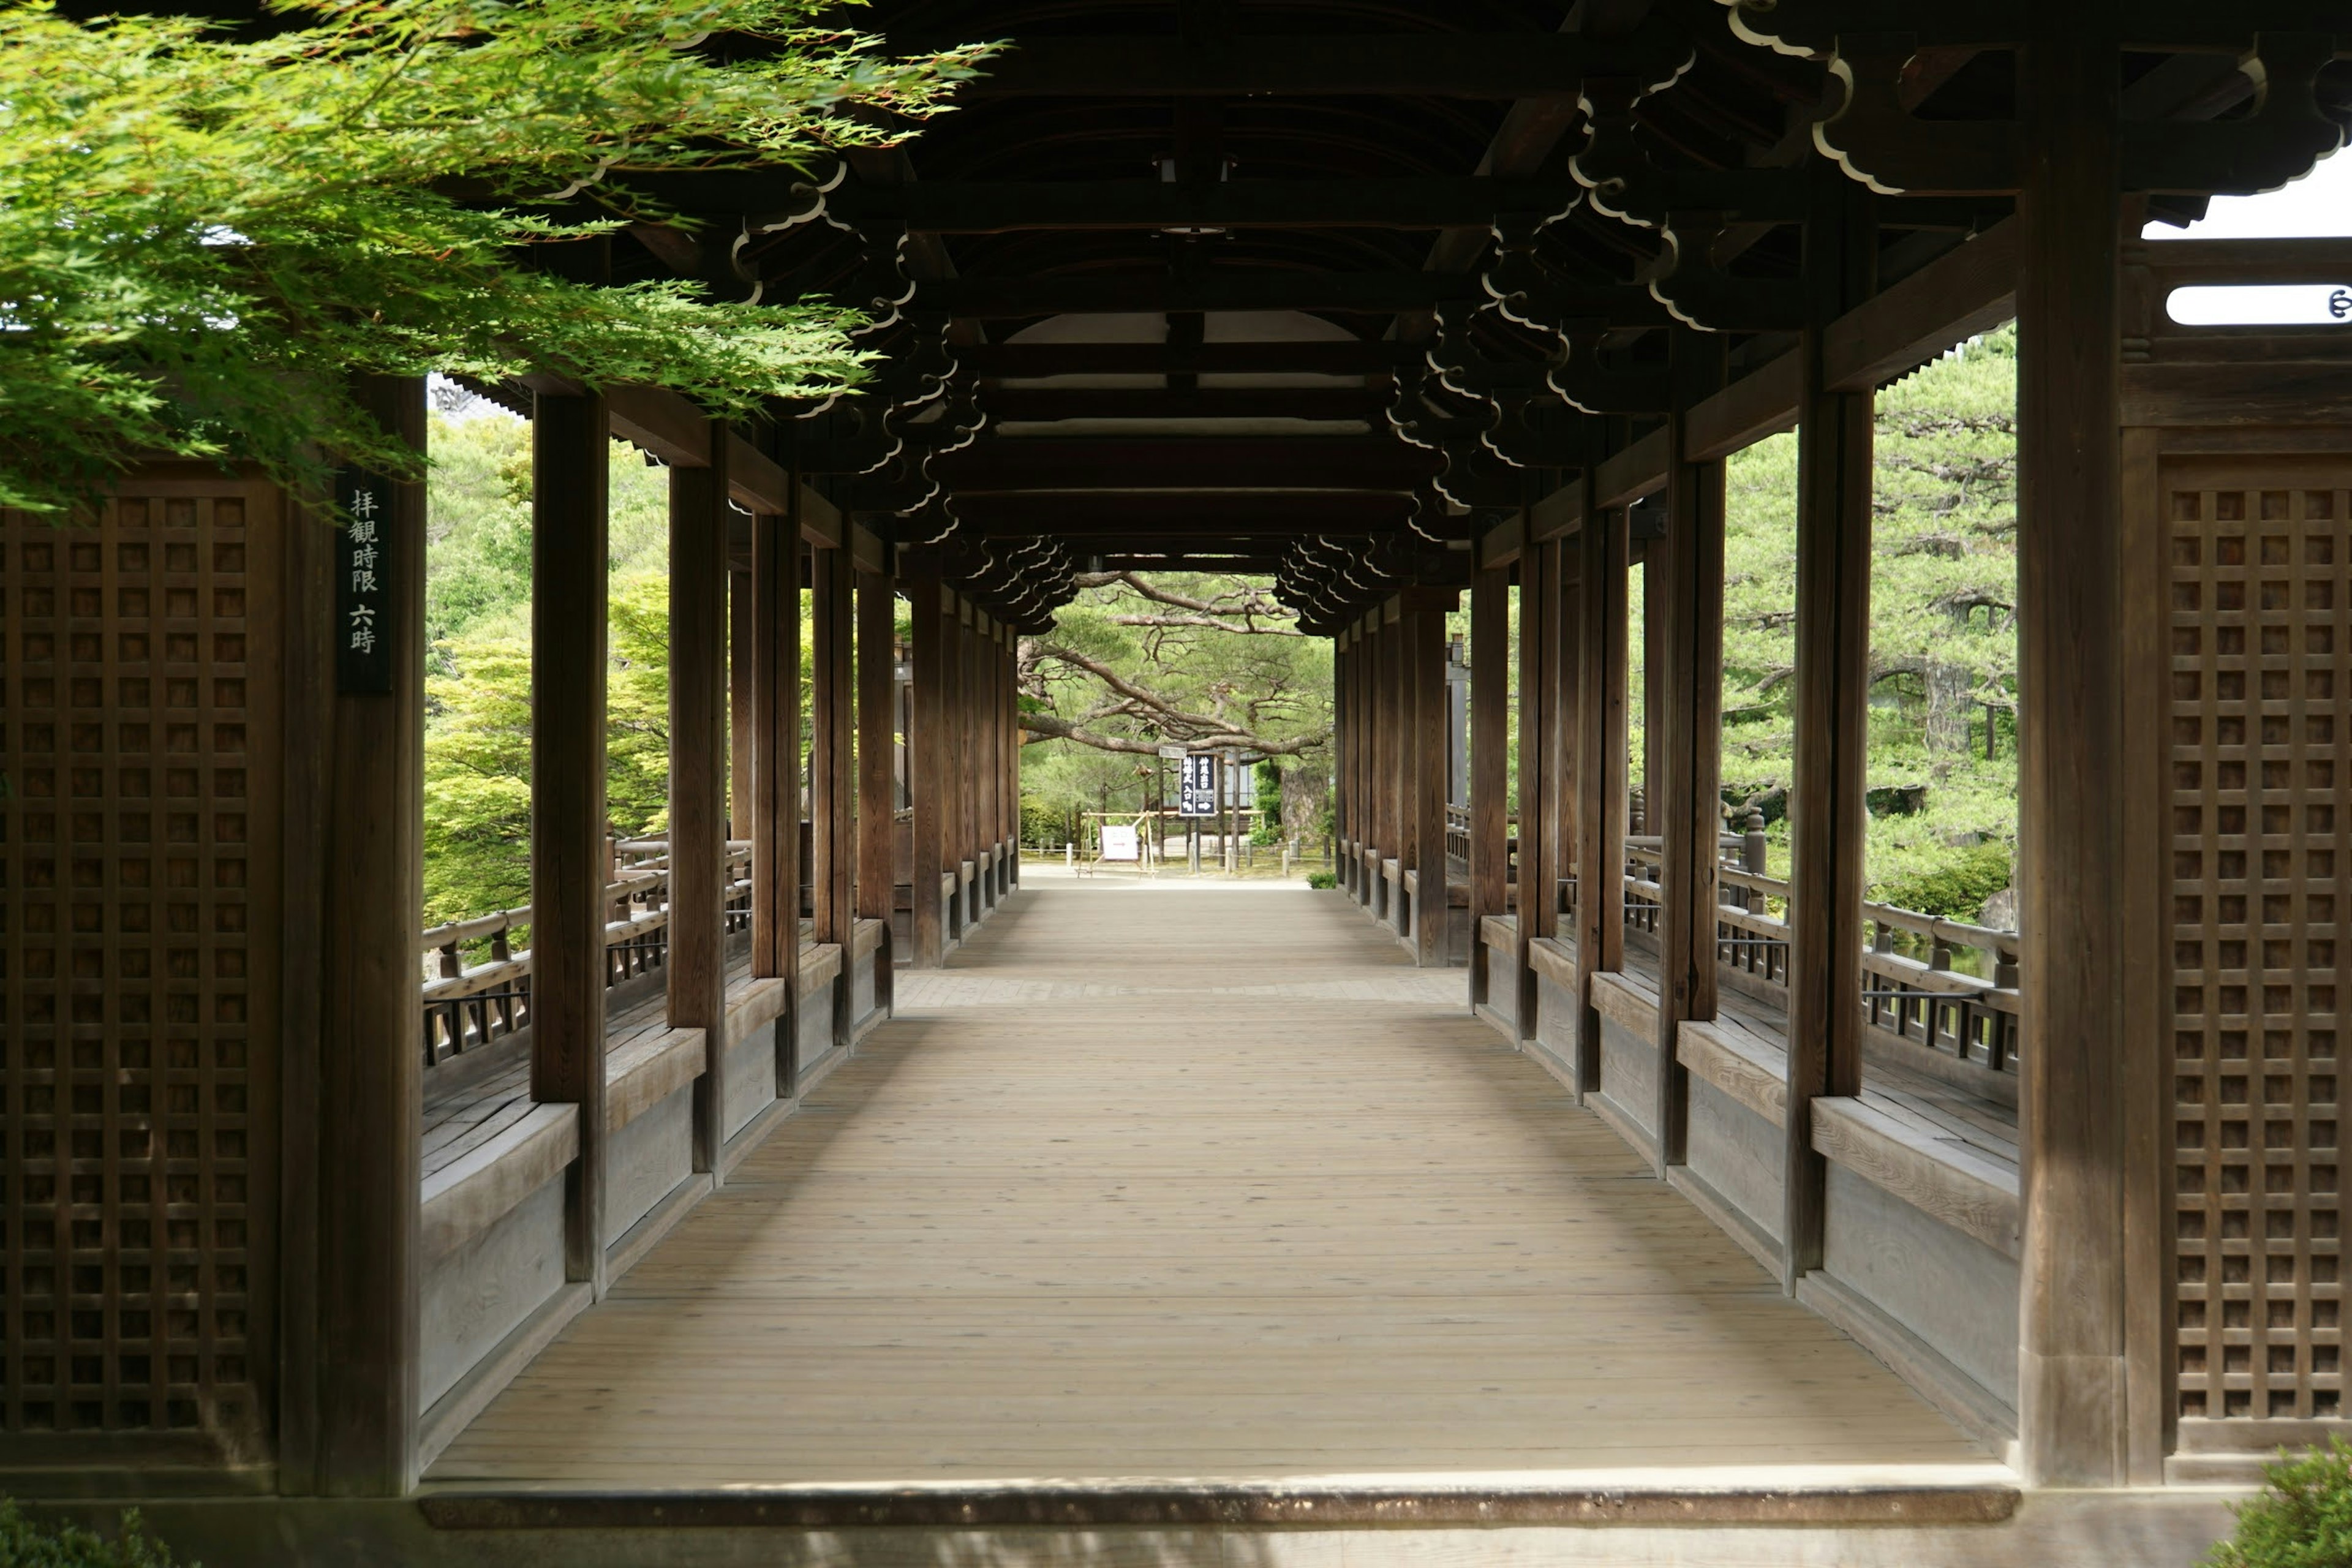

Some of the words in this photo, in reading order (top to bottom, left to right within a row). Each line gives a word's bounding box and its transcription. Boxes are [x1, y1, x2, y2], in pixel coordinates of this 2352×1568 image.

[347, 489, 379, 592] 拝観時限
[349, 603, 377, 654] 六時
[1183, 785, 1193, 801] 入口
